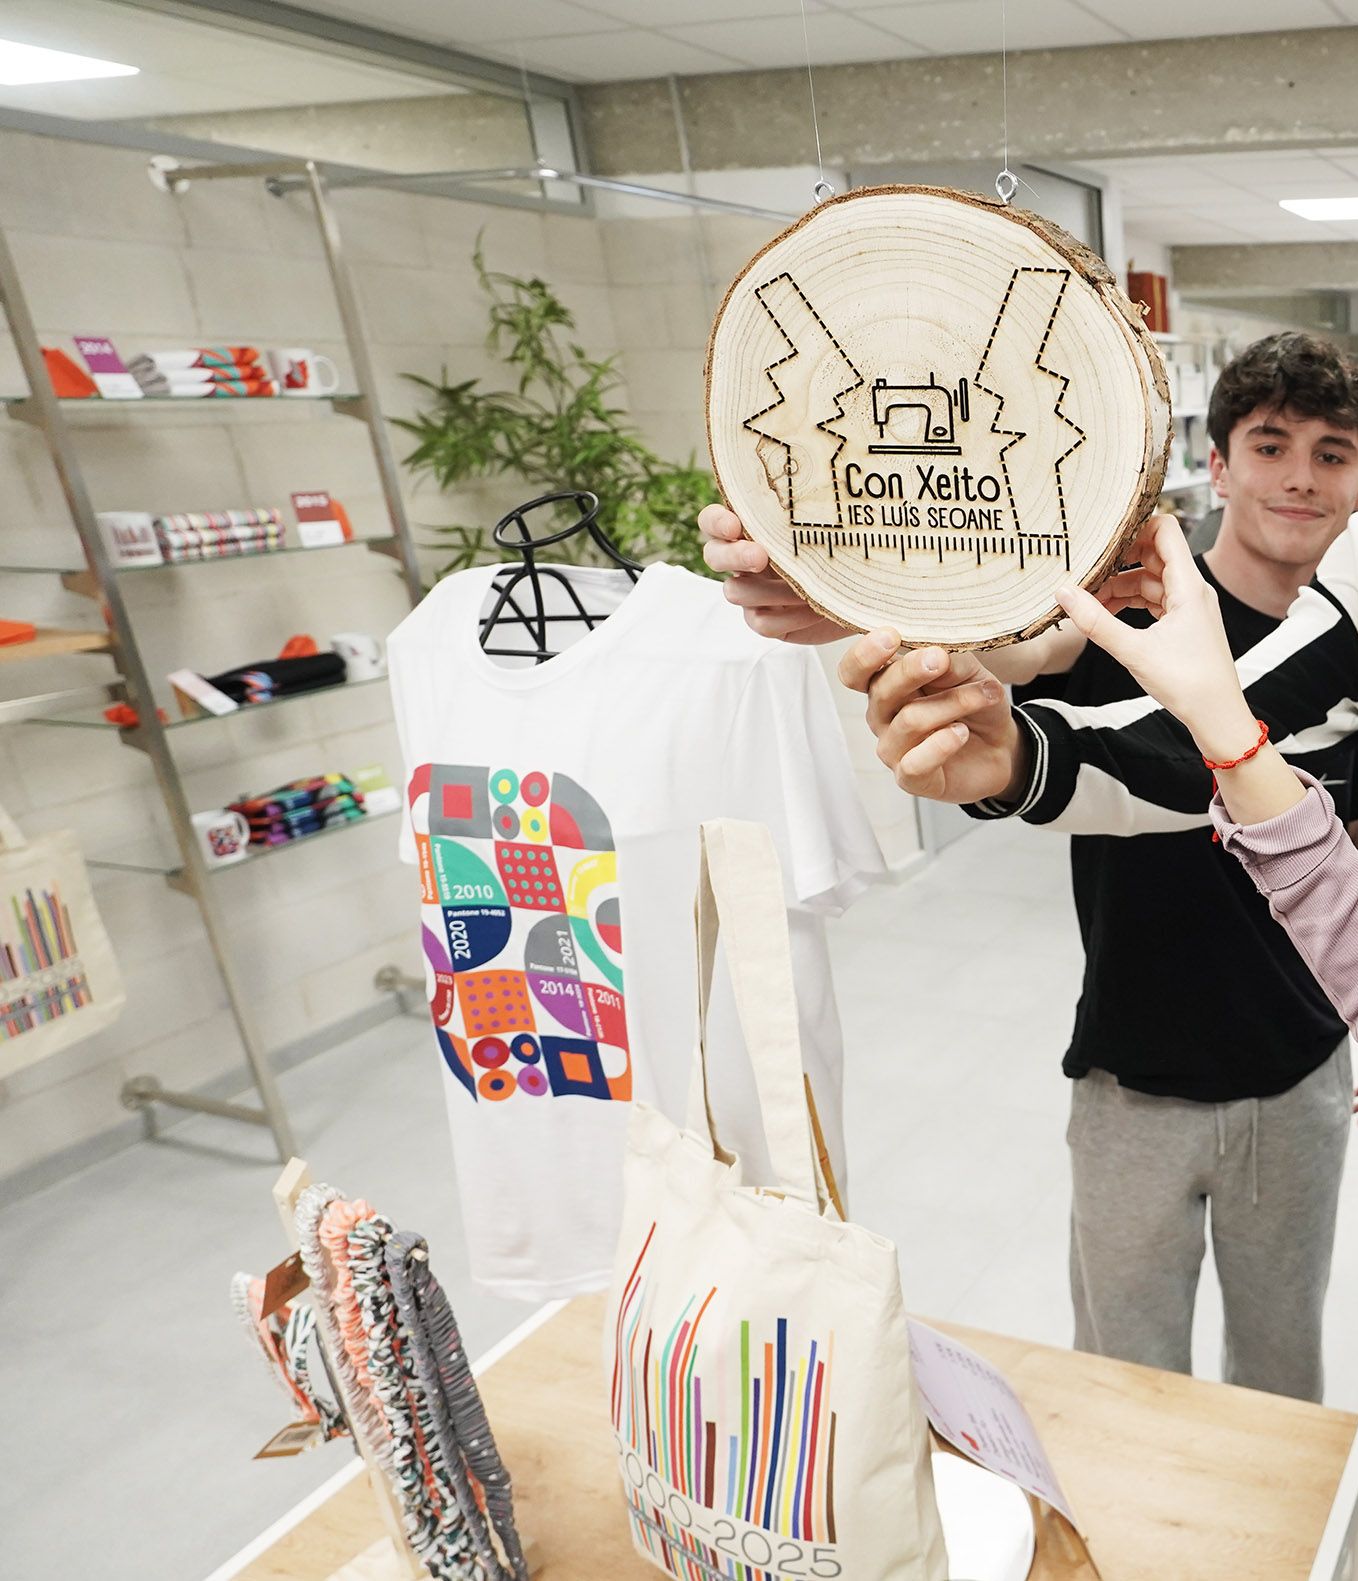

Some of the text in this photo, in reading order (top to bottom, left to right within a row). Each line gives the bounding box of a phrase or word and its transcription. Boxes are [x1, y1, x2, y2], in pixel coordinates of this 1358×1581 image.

[845, 463, 1001, 502] Con Xeito
[848, 500, 1004, 531] IES LUÍS SEOANE
[453, 884, 494, 900] 2010
[449, 920, 471, 960] 2020
[556, 930, 576, 966] 2021
[539, 980, 575, 997] 2014
[595, 989, 622, 1010] 2011
